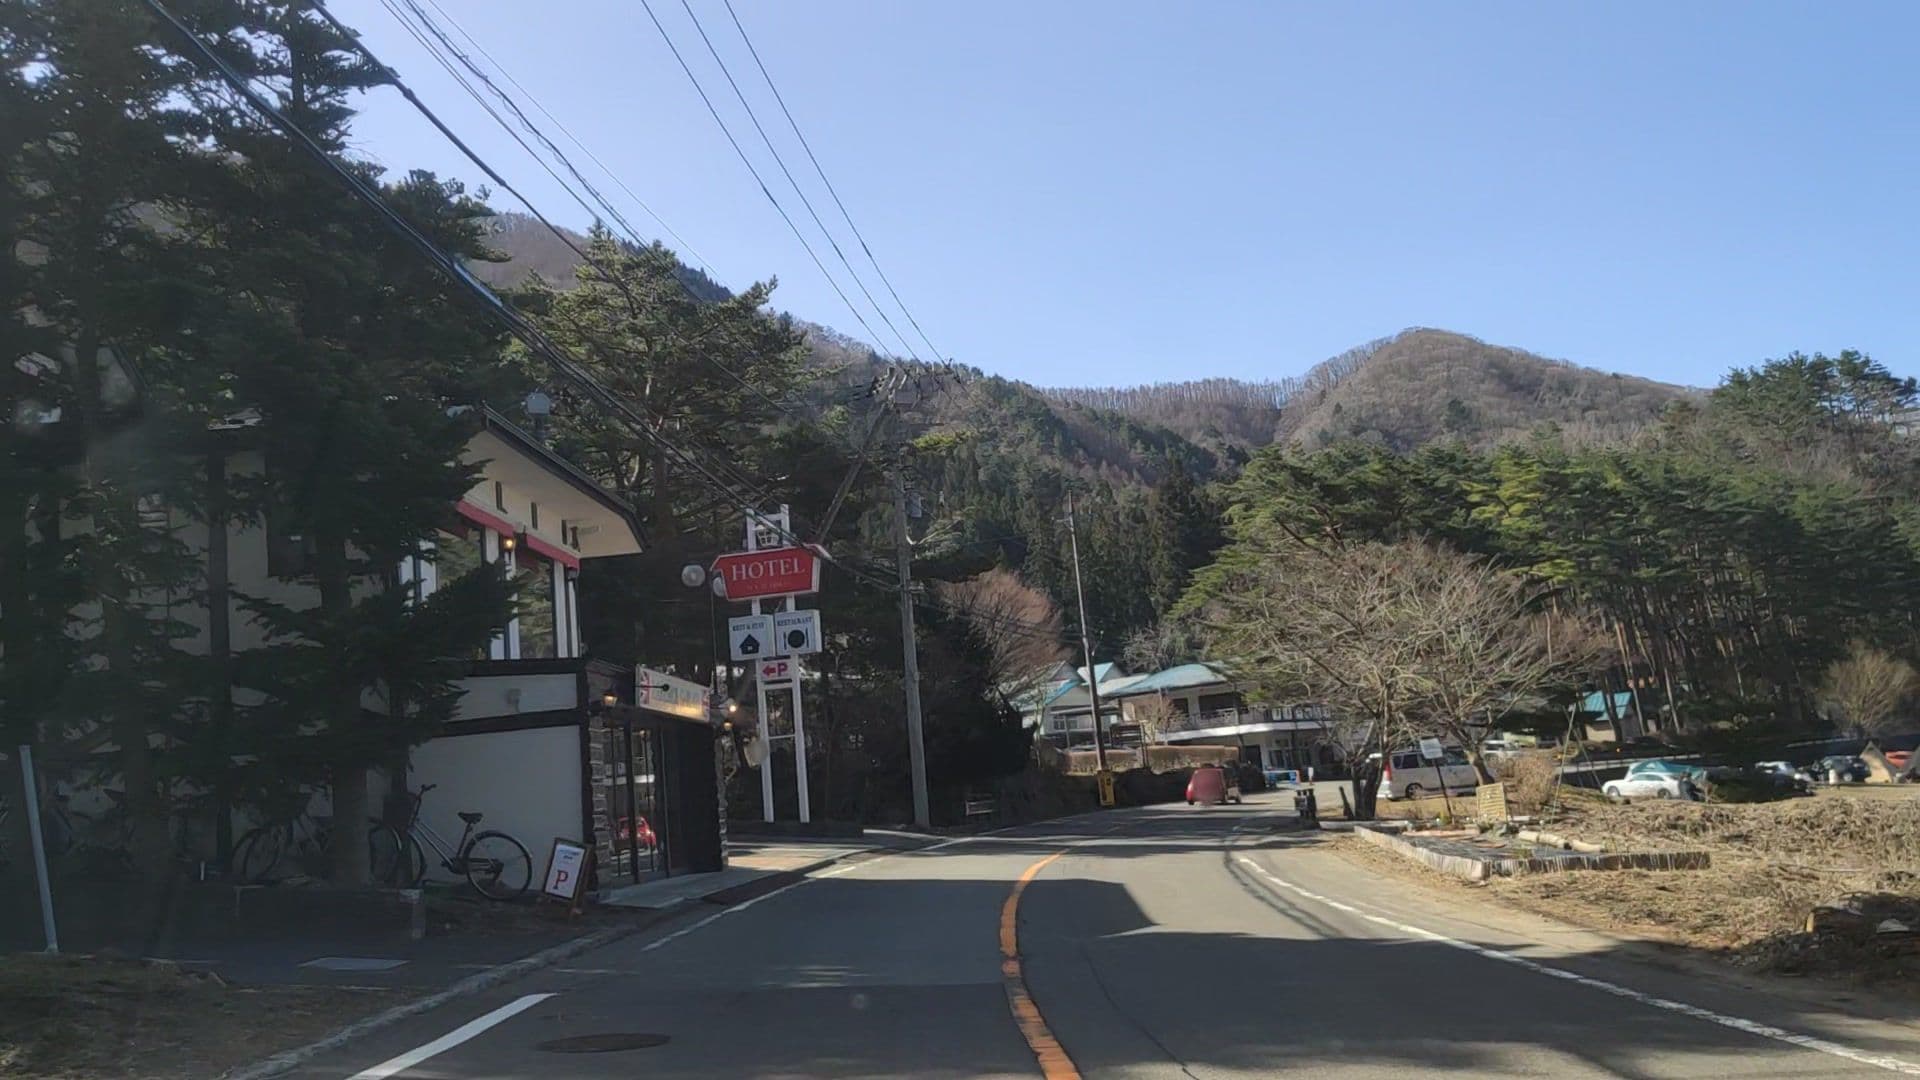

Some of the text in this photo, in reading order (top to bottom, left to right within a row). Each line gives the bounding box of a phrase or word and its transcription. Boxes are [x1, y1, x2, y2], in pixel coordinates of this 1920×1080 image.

[732, 557, 805, 581] HOTEL
[777, 662, 788, 676] P
[553, 870, 568, 890] P
